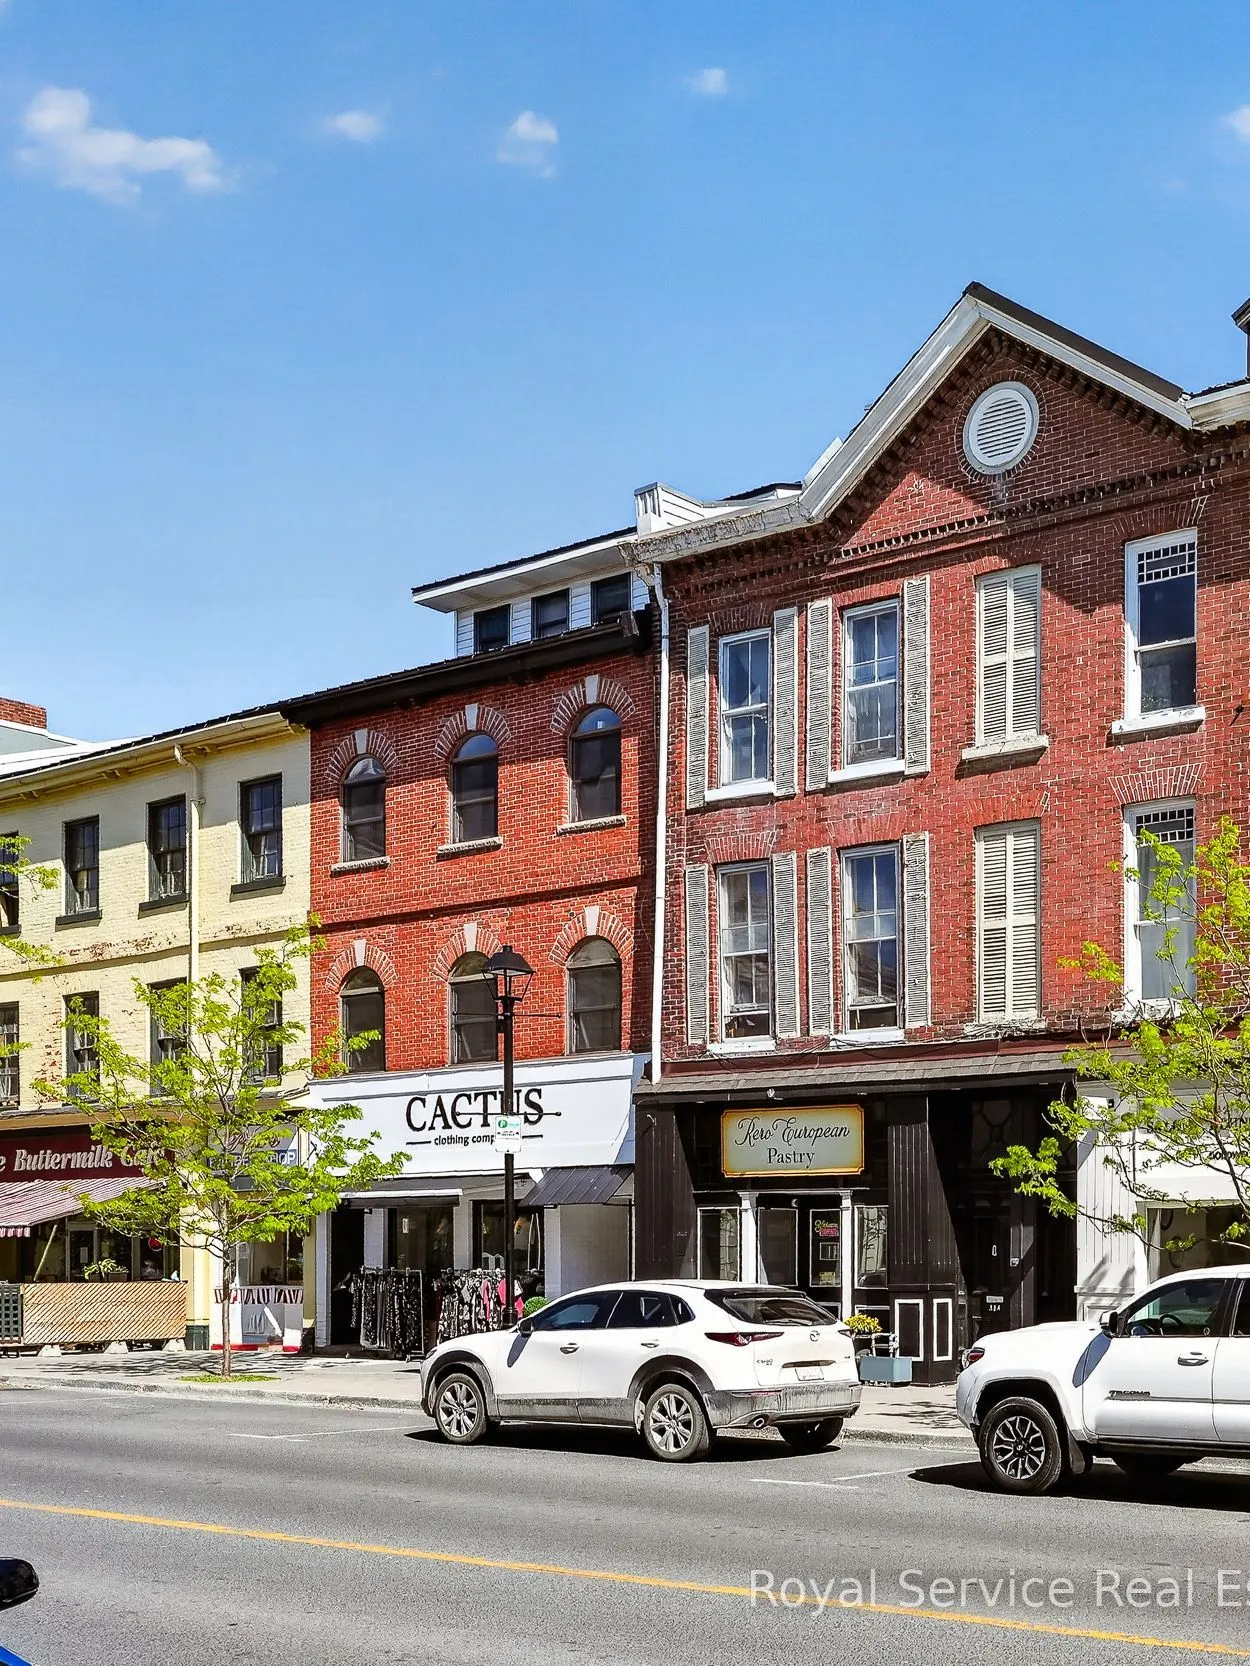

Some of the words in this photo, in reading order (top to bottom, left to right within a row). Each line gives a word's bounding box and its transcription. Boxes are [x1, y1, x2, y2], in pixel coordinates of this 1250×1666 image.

[434, 1134, 469, 1146] clothing
[772, 1116, 850, 1147] European
[13, 1144, 113, 1172] Buttermilk
[767, 1147, 815, 1169] Pastry
